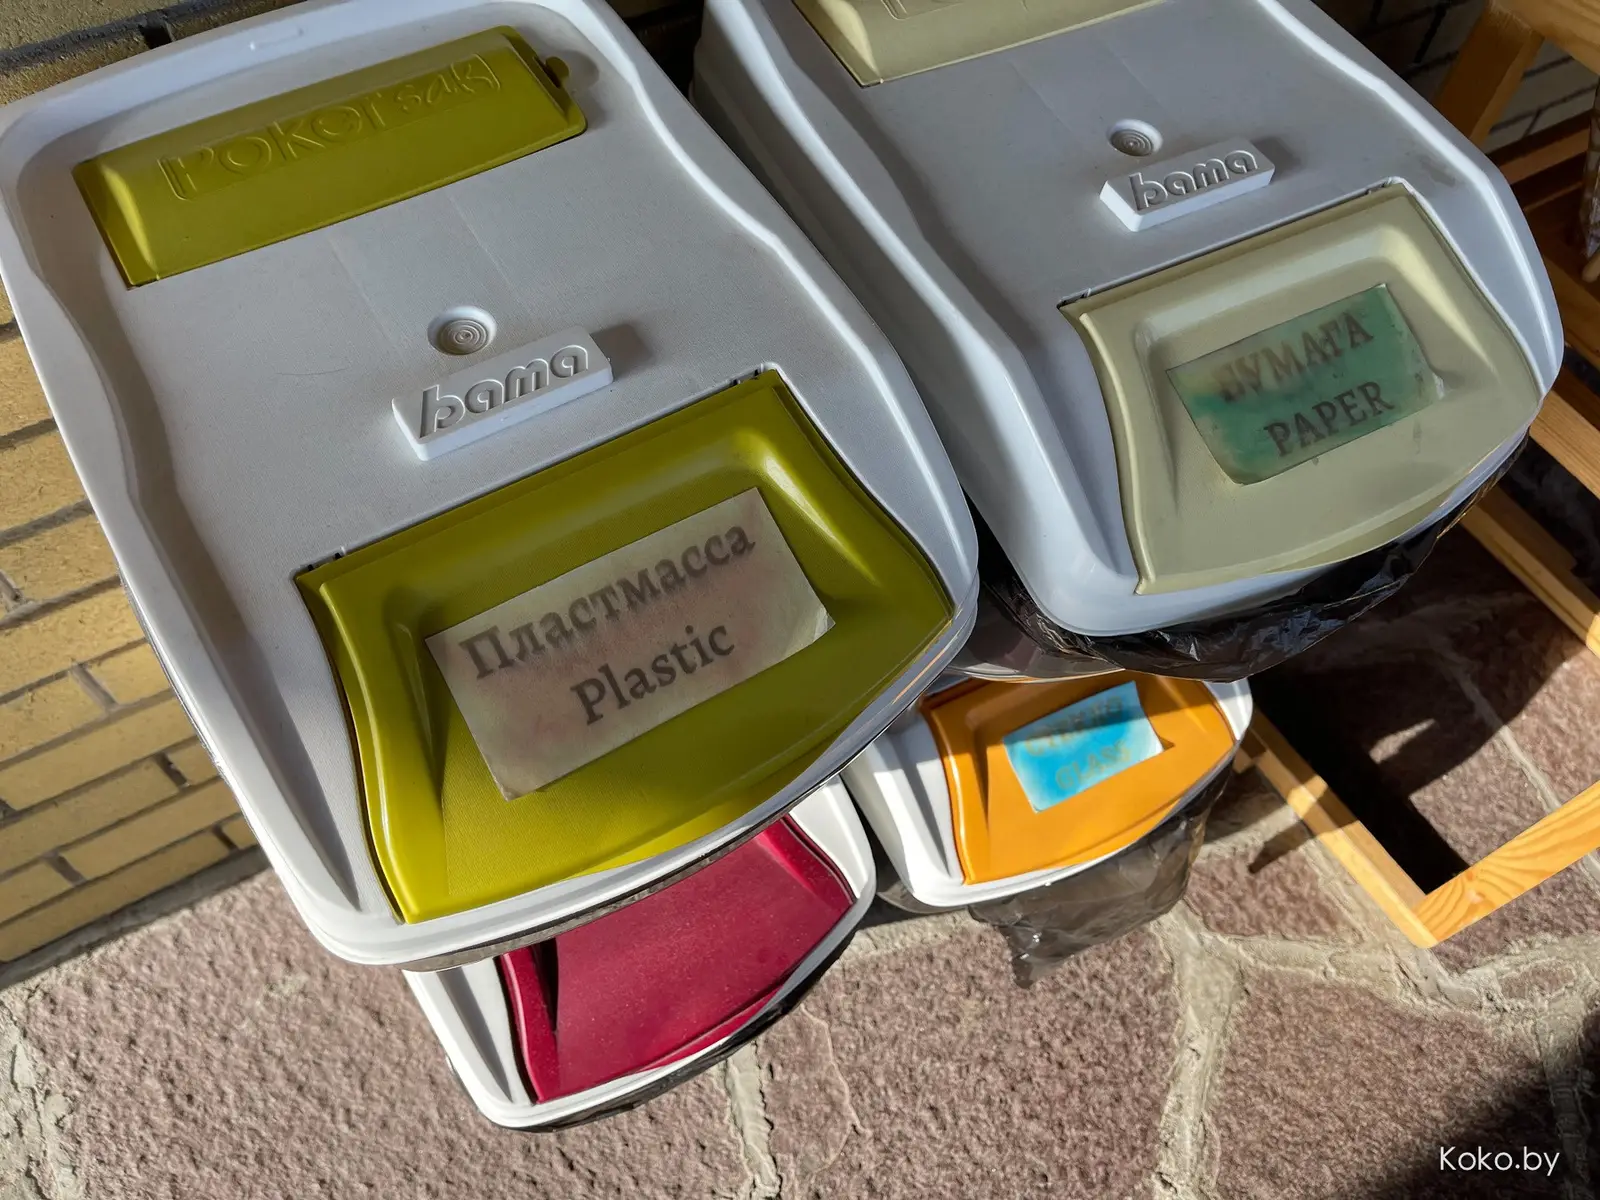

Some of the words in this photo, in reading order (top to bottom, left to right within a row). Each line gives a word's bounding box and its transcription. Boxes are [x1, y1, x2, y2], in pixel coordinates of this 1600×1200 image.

[1128, 150, 1259, 211] bama
[419, 344, 589, 439] bama
[1263, 380, 1396, 458] PAPER
[459, 525, 757, 681] Пластмасса
[570, 624, 736, 726] Plastic
